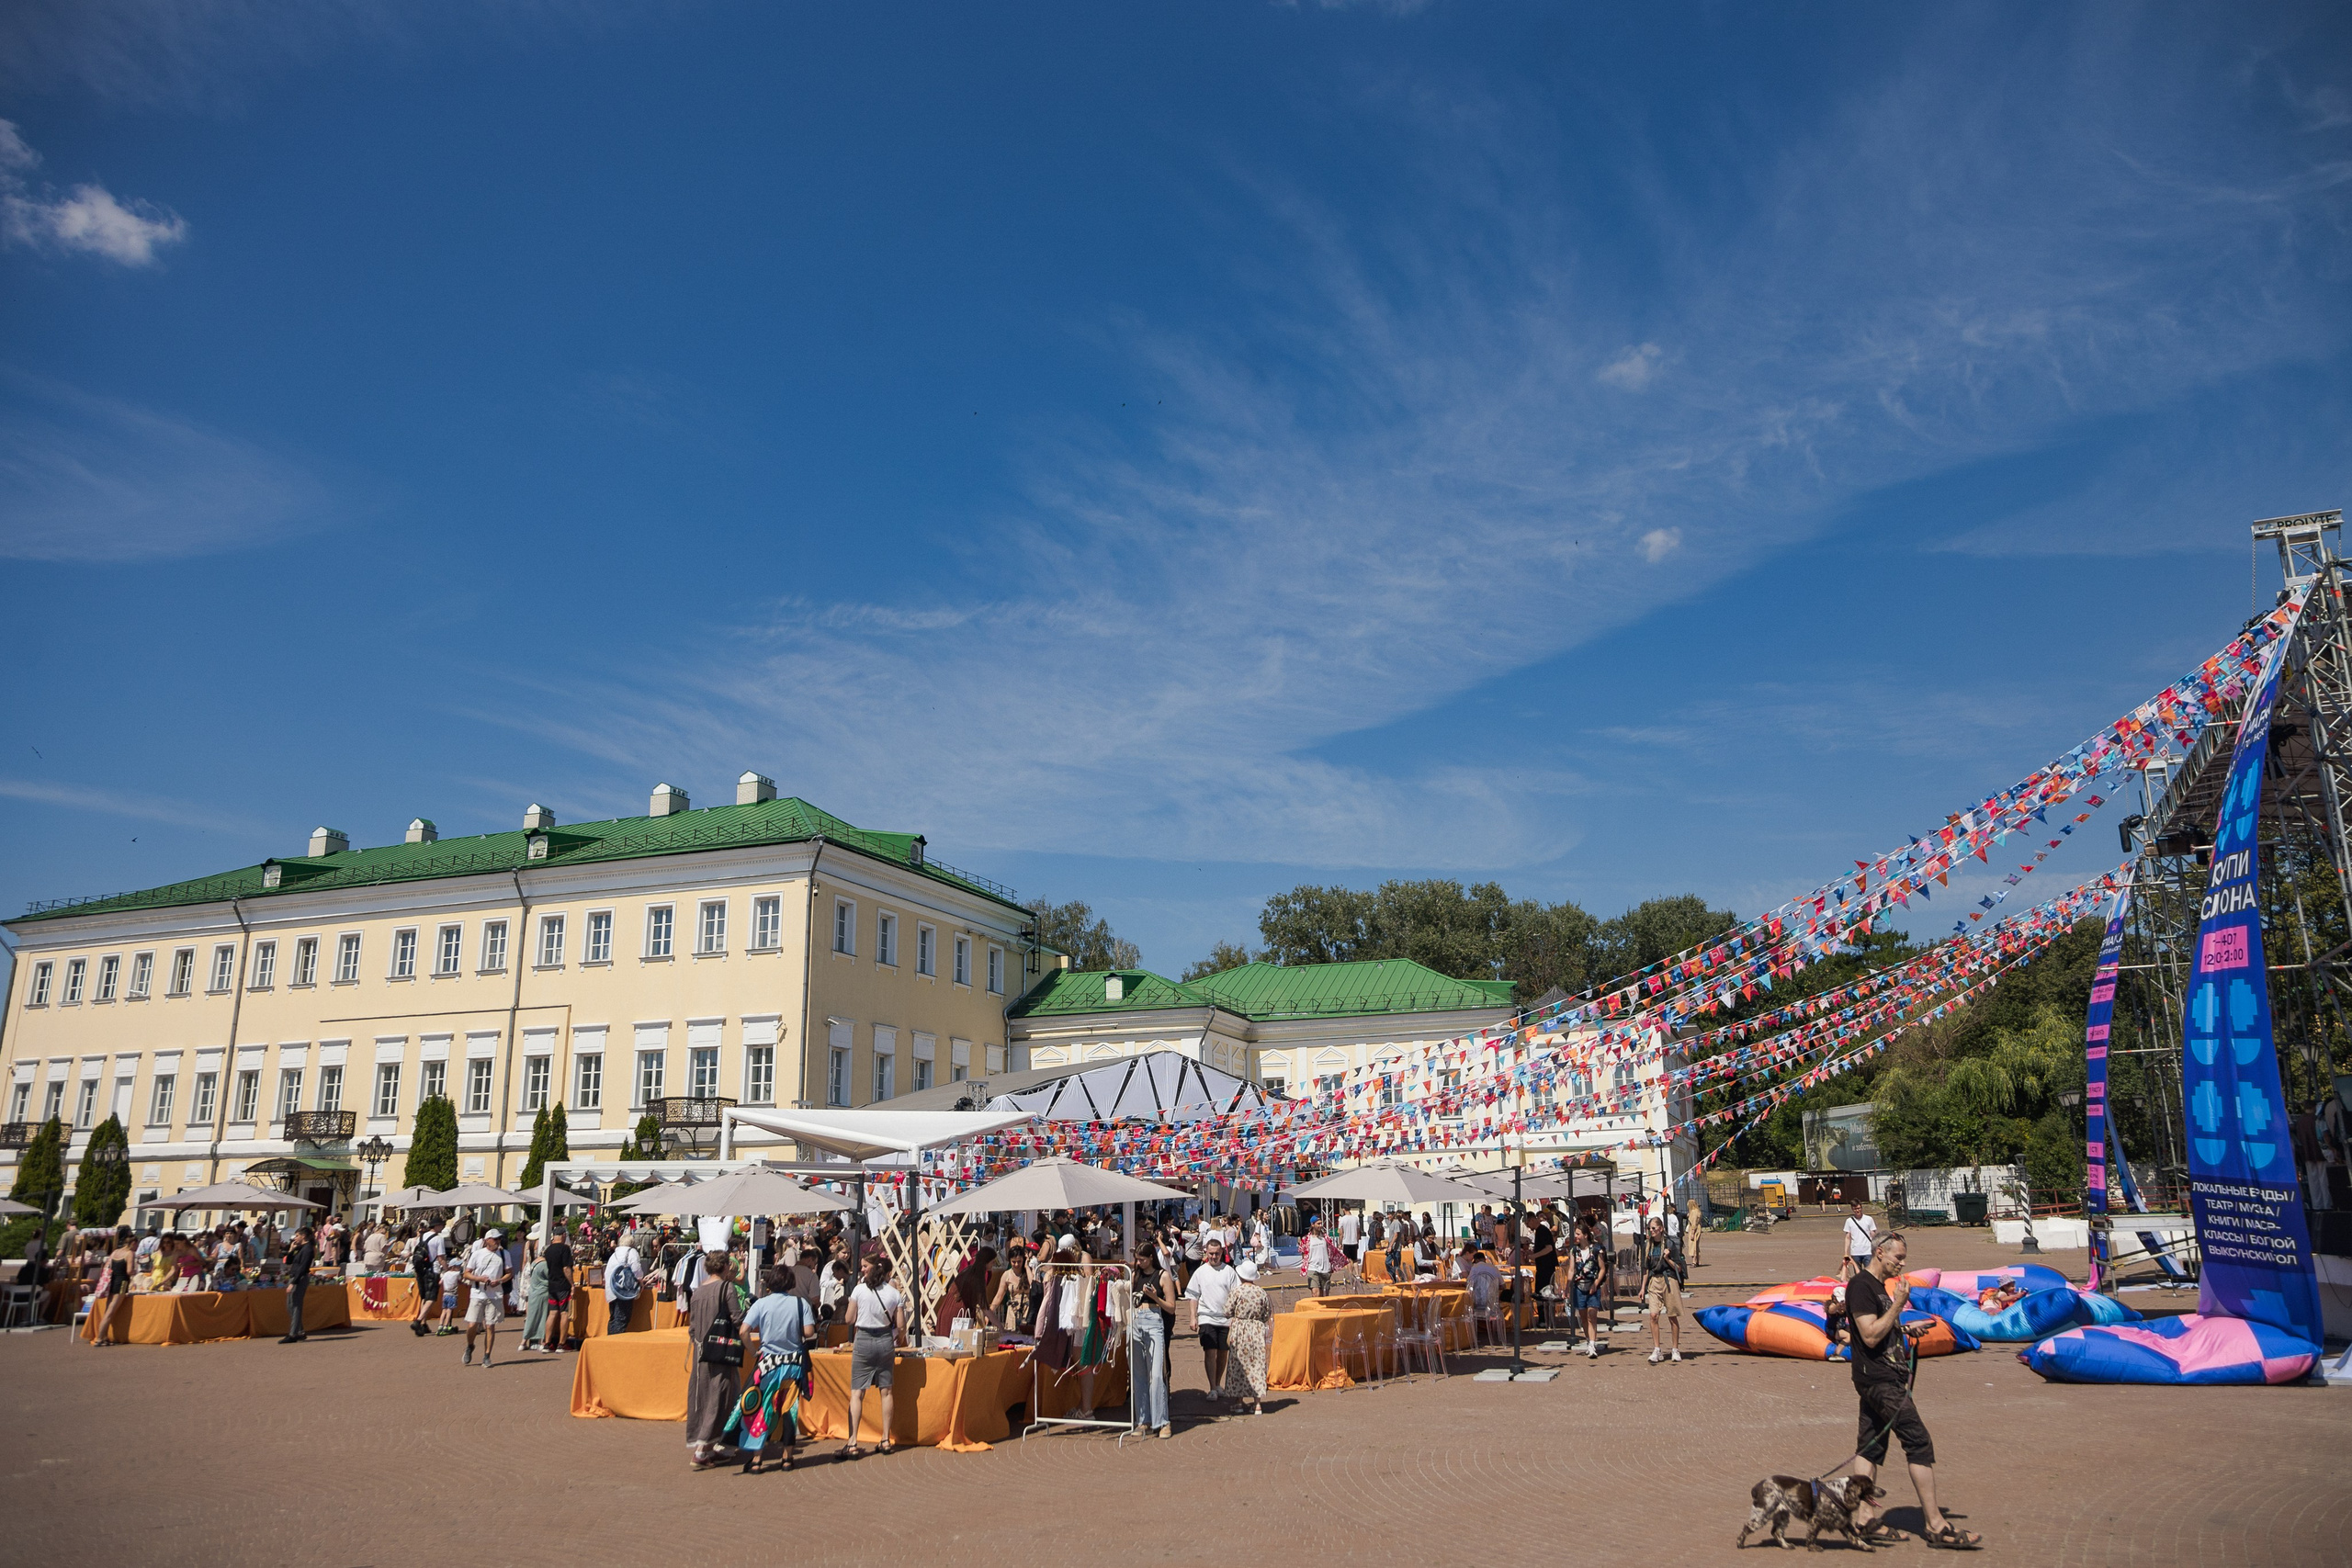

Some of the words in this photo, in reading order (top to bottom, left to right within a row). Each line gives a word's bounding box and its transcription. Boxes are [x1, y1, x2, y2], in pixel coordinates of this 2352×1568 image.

[2277, 514, 2333, 528] PROLYTE
[2211, 850, 2249, 887] КУПИ
[2200, 883, 2256, 920] СЛОНА
[2192, 1182, 2249, 1196] ЛОКАЛЬНЫЕ
[2205, 1199, 2233, 1211] ТЕАТР
[2208, 1214, 2240, 1227] КНИГИ
[2203, 1229, 2245, 1243] КЛАССЫ
